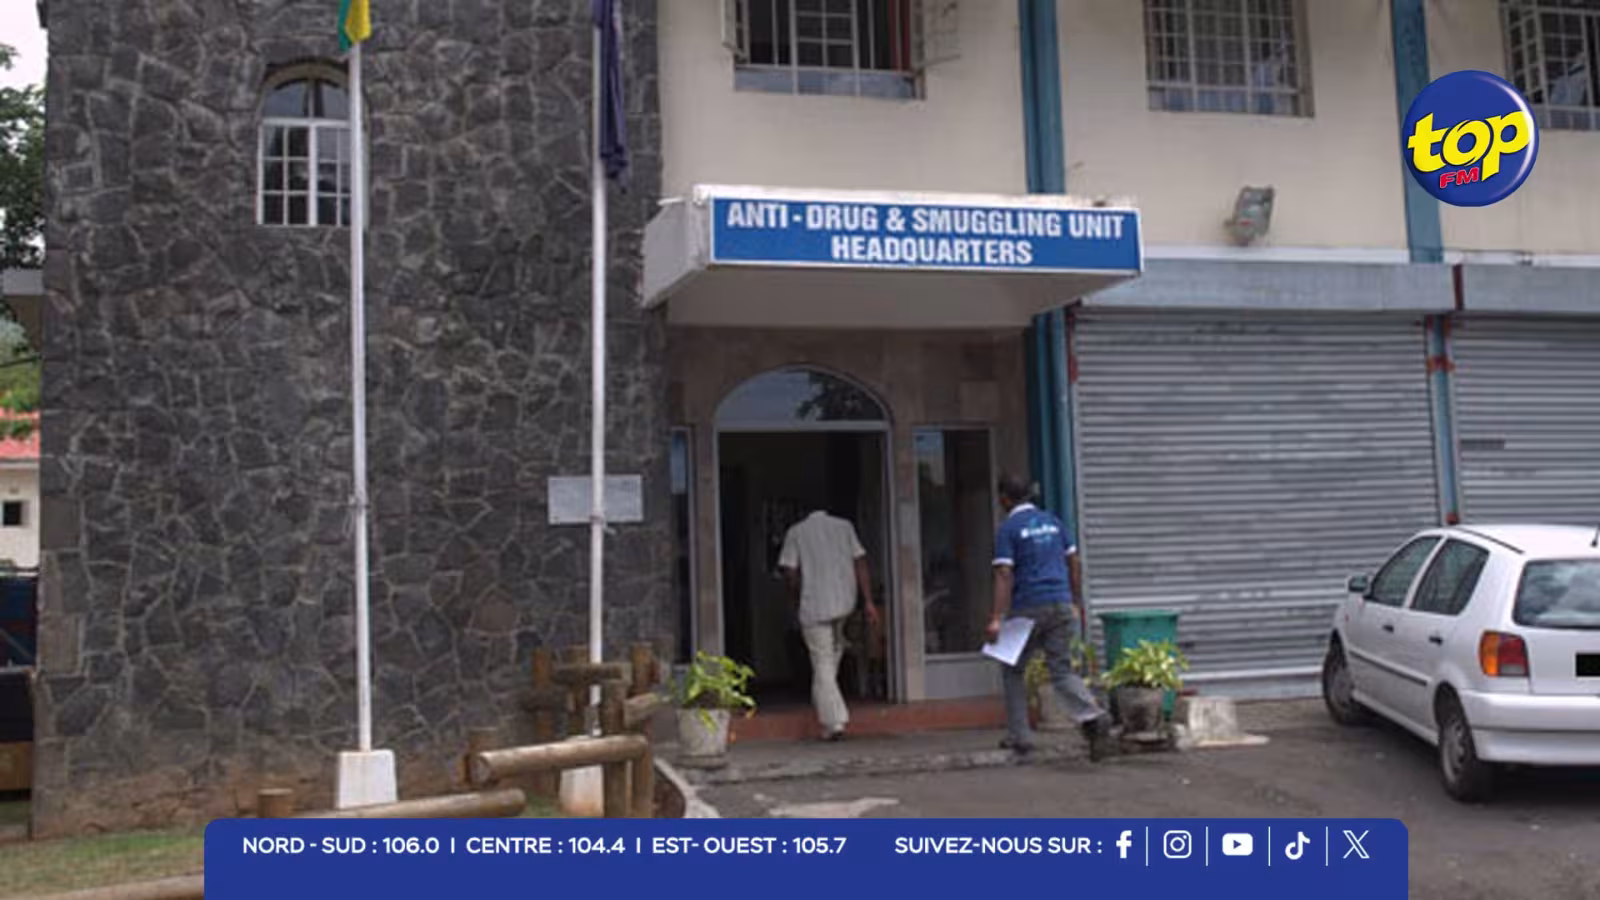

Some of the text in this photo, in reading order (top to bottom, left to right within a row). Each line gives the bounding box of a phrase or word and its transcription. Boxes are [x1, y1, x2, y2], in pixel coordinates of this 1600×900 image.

[727, 202, 788, 229] ANTI
[806, 205, 878, 231] DRUG
[886, 207, 905, 232] &
[912, 208, 1062, 237] SMUGGLING
[1069, 213, 1124, 239] UNIT
[831, 235, 1033, 264] HEADQUARTERS
